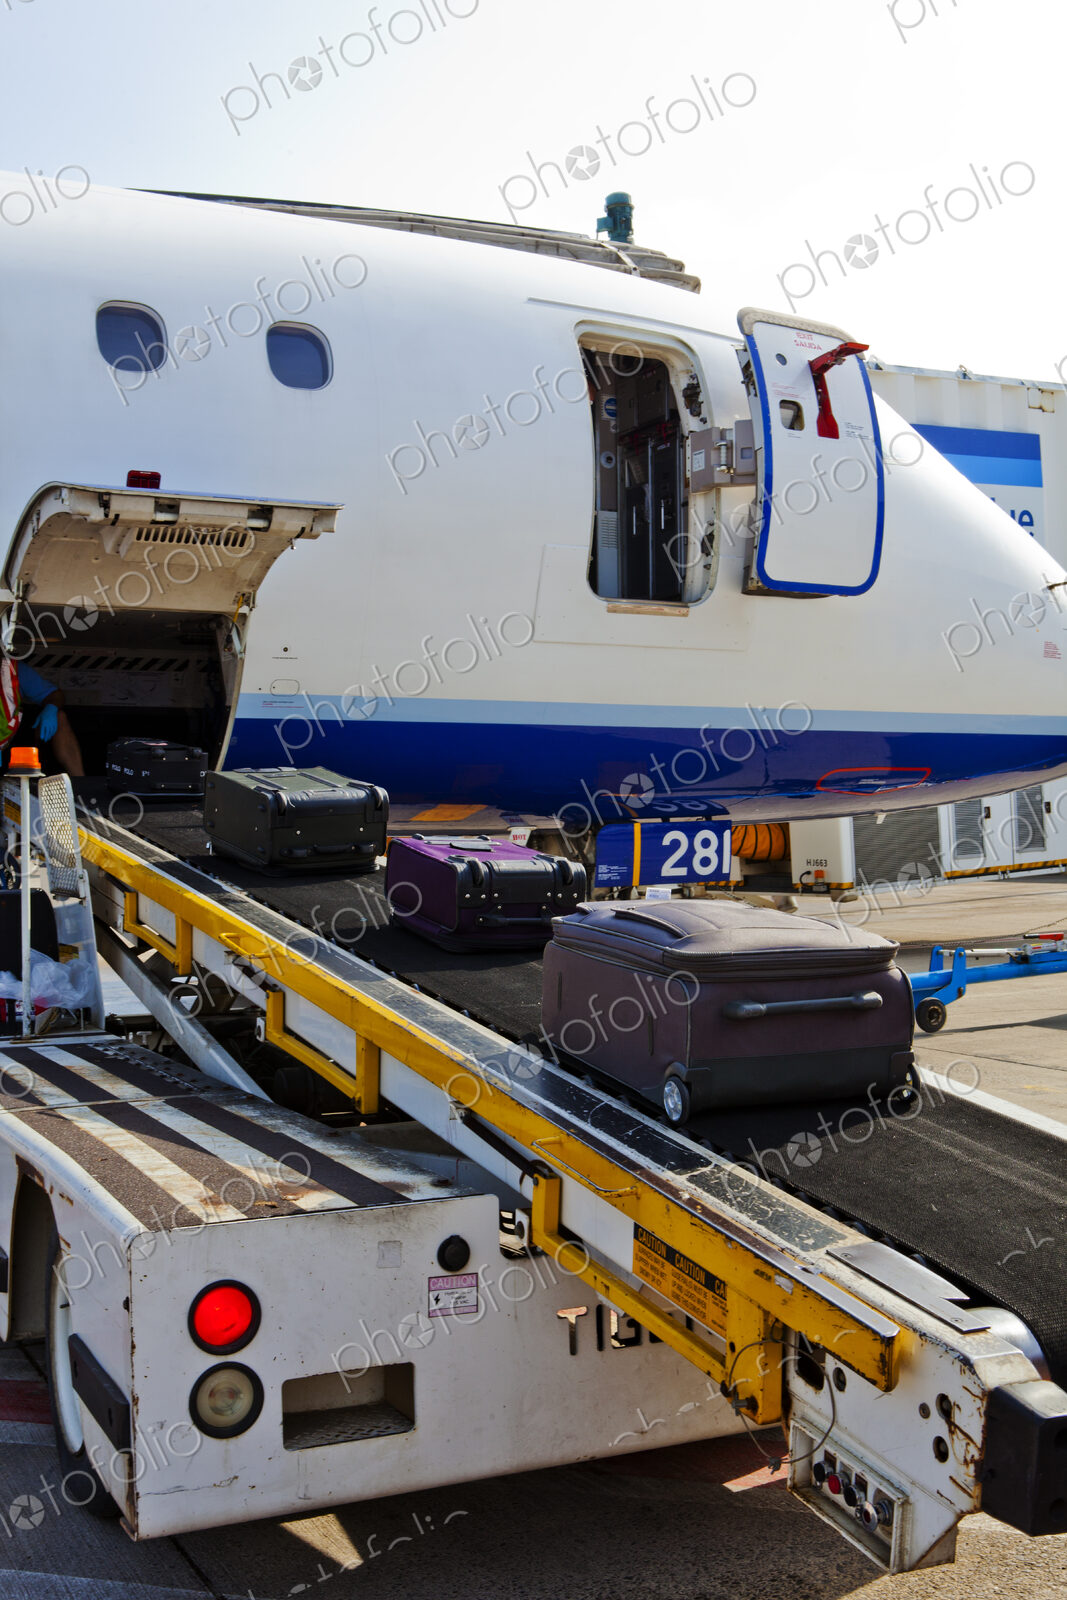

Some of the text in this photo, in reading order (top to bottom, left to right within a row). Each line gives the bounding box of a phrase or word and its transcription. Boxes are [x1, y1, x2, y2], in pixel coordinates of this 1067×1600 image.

[661, 829, 731, 877] 281
[638, 1228, 667, 1258] CAUTION
[675, 1254, 706, 1285] CAUTION
[431, 1275, 476, 1289] CAUTION
